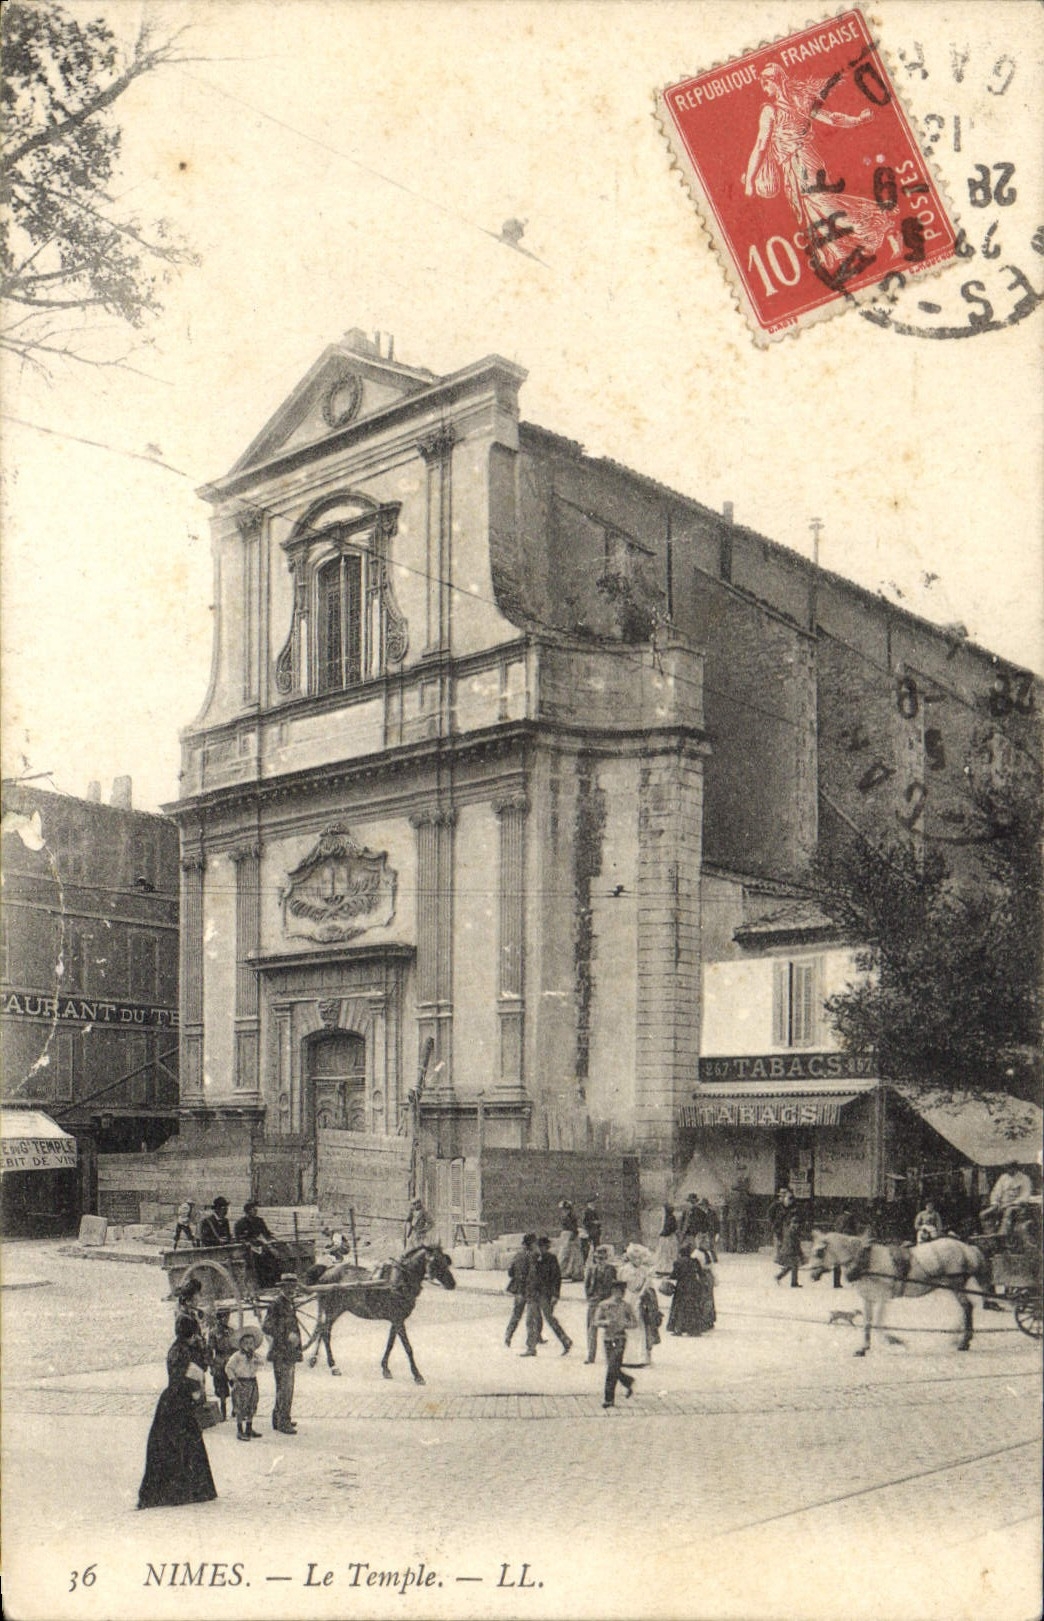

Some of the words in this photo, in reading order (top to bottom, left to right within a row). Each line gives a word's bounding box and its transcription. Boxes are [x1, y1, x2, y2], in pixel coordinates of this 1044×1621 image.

[780, 21, 861, 67] FRANÇAISE
[894, 158, 943, 242] POSTES
[0, 993, 116, 1022] AURANT
[120, 1008, 146, 1024] DU
[733, 1055, 842, 1078] TABACS
[699, 1104, 819, 1125] TABACS
[31, 1139, 76, 1155] TEMPLE
[32, 1156, 50, 1166] DE
